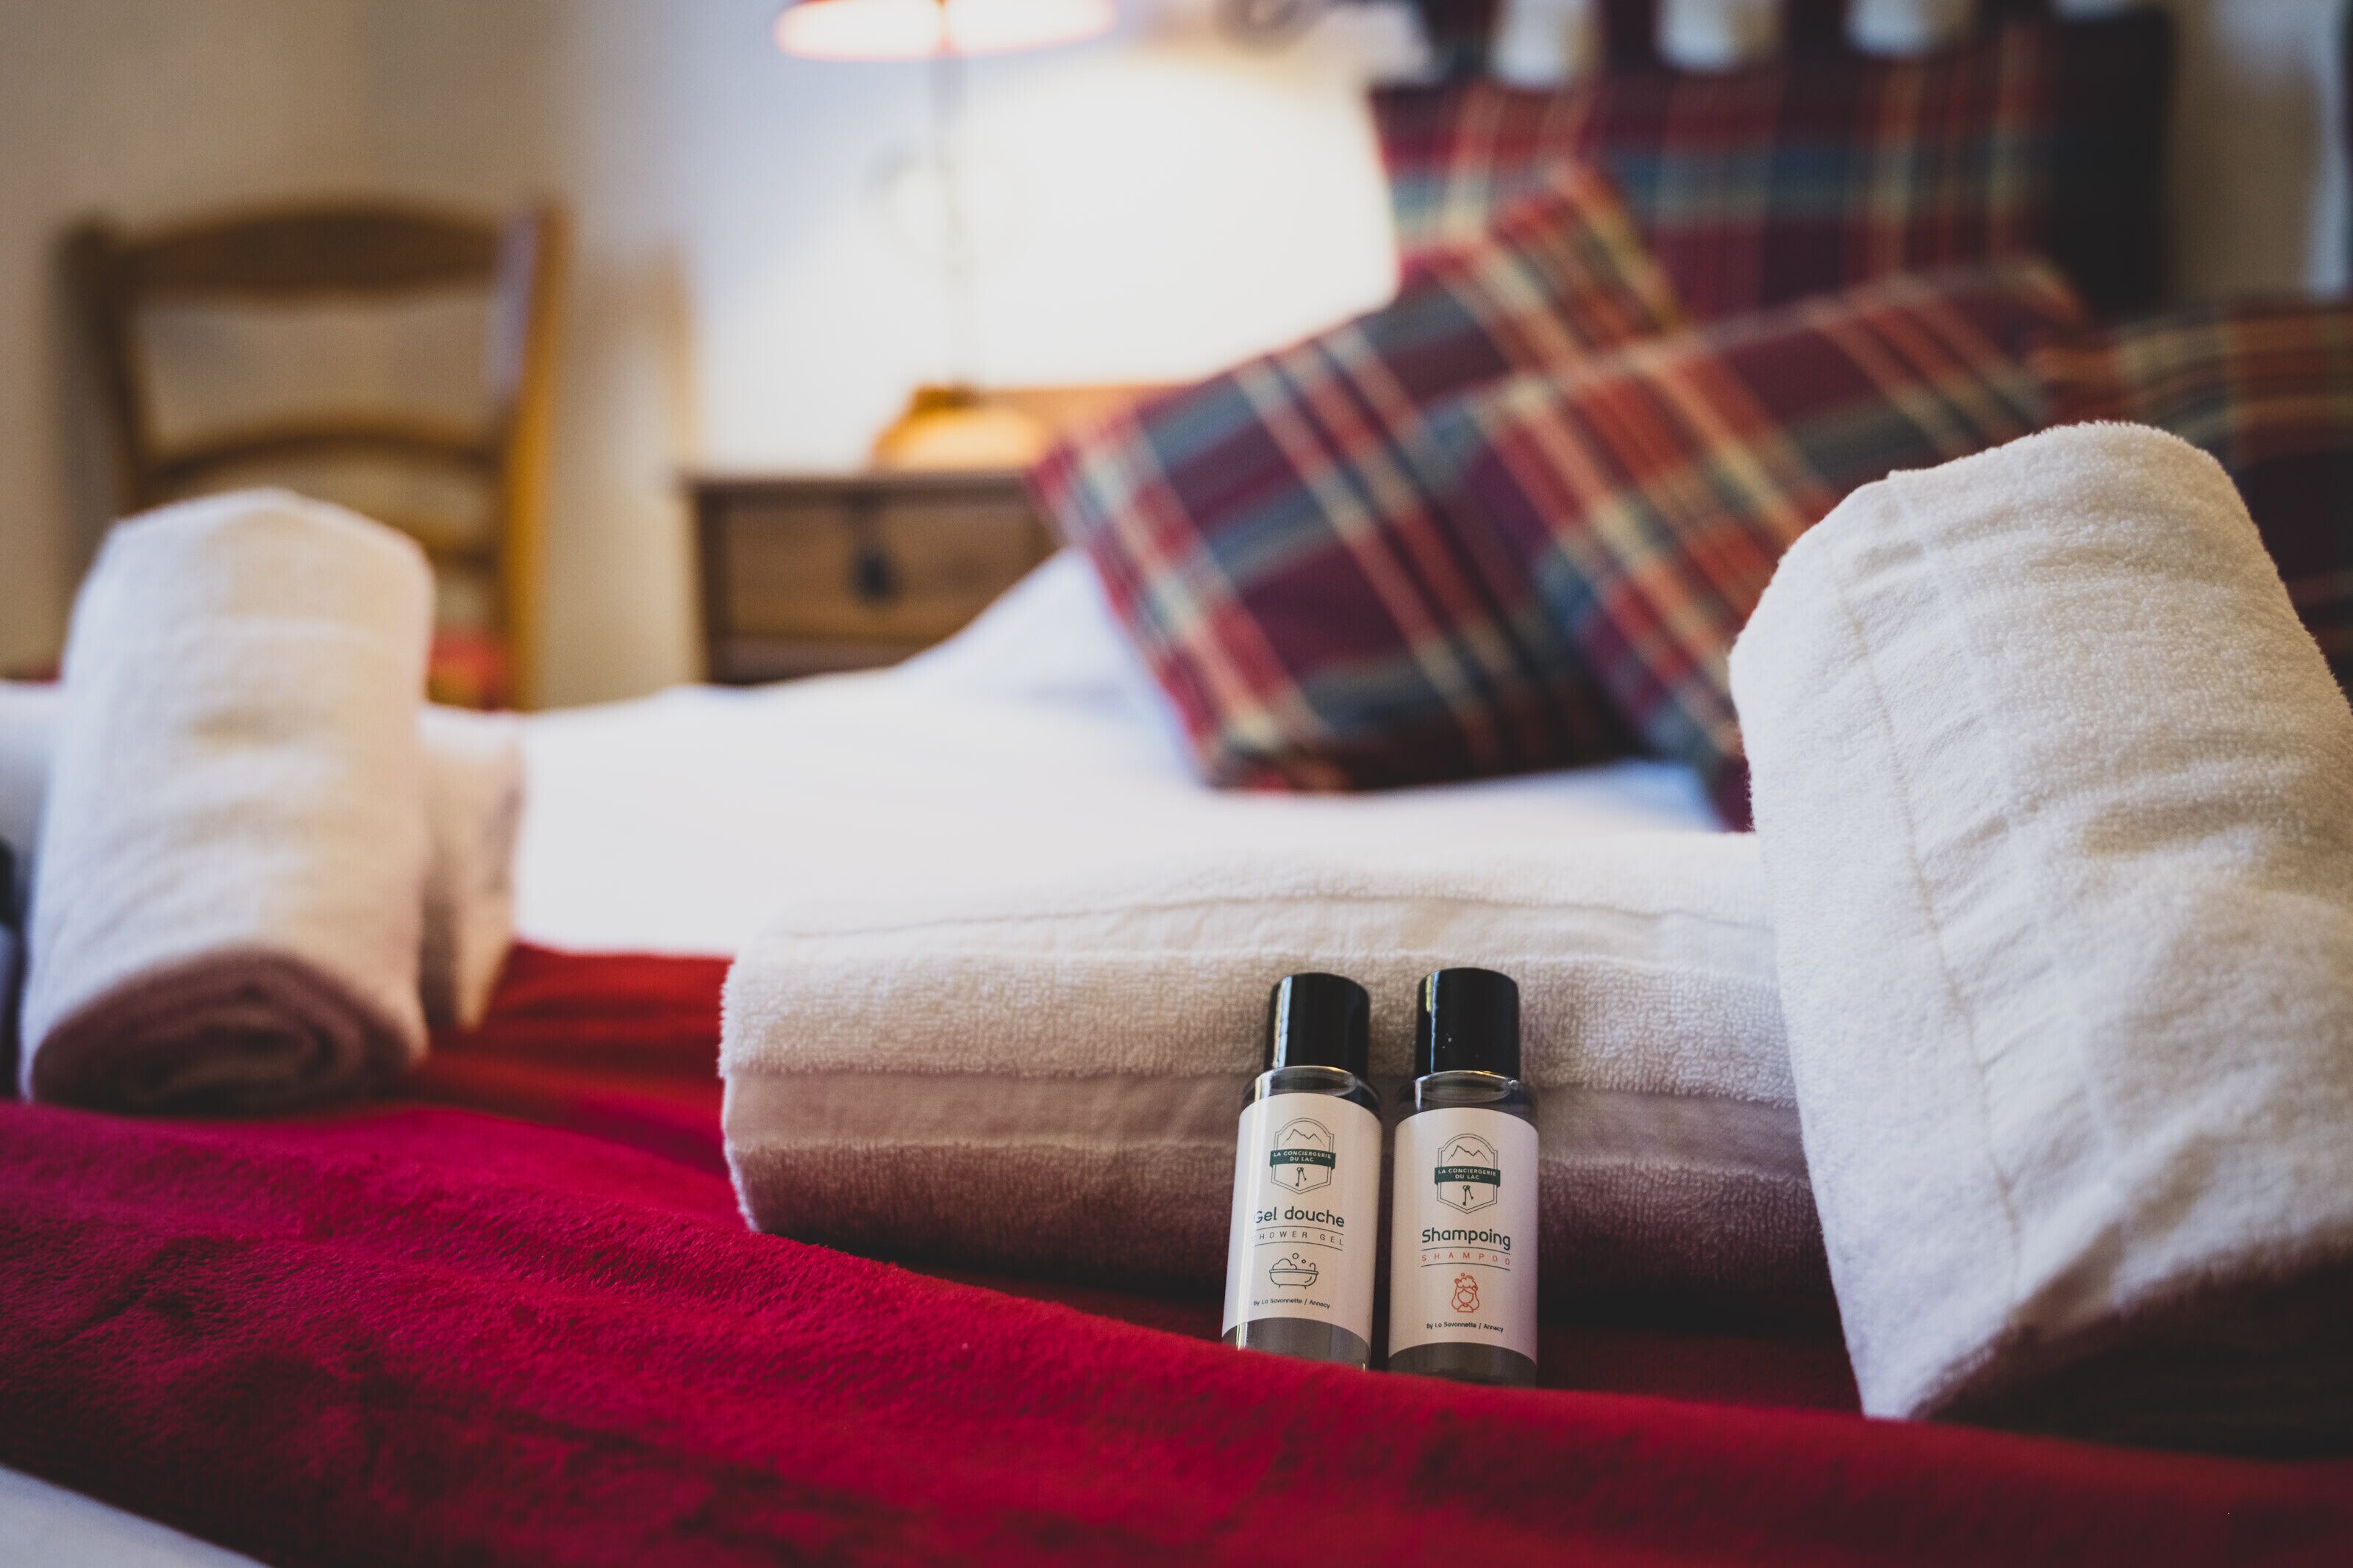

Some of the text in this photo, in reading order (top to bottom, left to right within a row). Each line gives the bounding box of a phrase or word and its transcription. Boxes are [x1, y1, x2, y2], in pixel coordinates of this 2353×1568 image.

[1283, 1150, 1331, 1159] CONCIERGERIE
[1448, 1167, 1496, 1176] CONCIERGERIE
[1254, 1206, 1345, 1228] Gel douche
[1253, 1231, 1344, 1245] HOWER GEL
[1421, 1227, 1511, 1250] Shampoing
[1421, 1252, 1510, 1265] SHAMPOO
[1310, 1300, 1330, 1309] Annecy
[1483, 1323, 1504, 1333] Annecy
